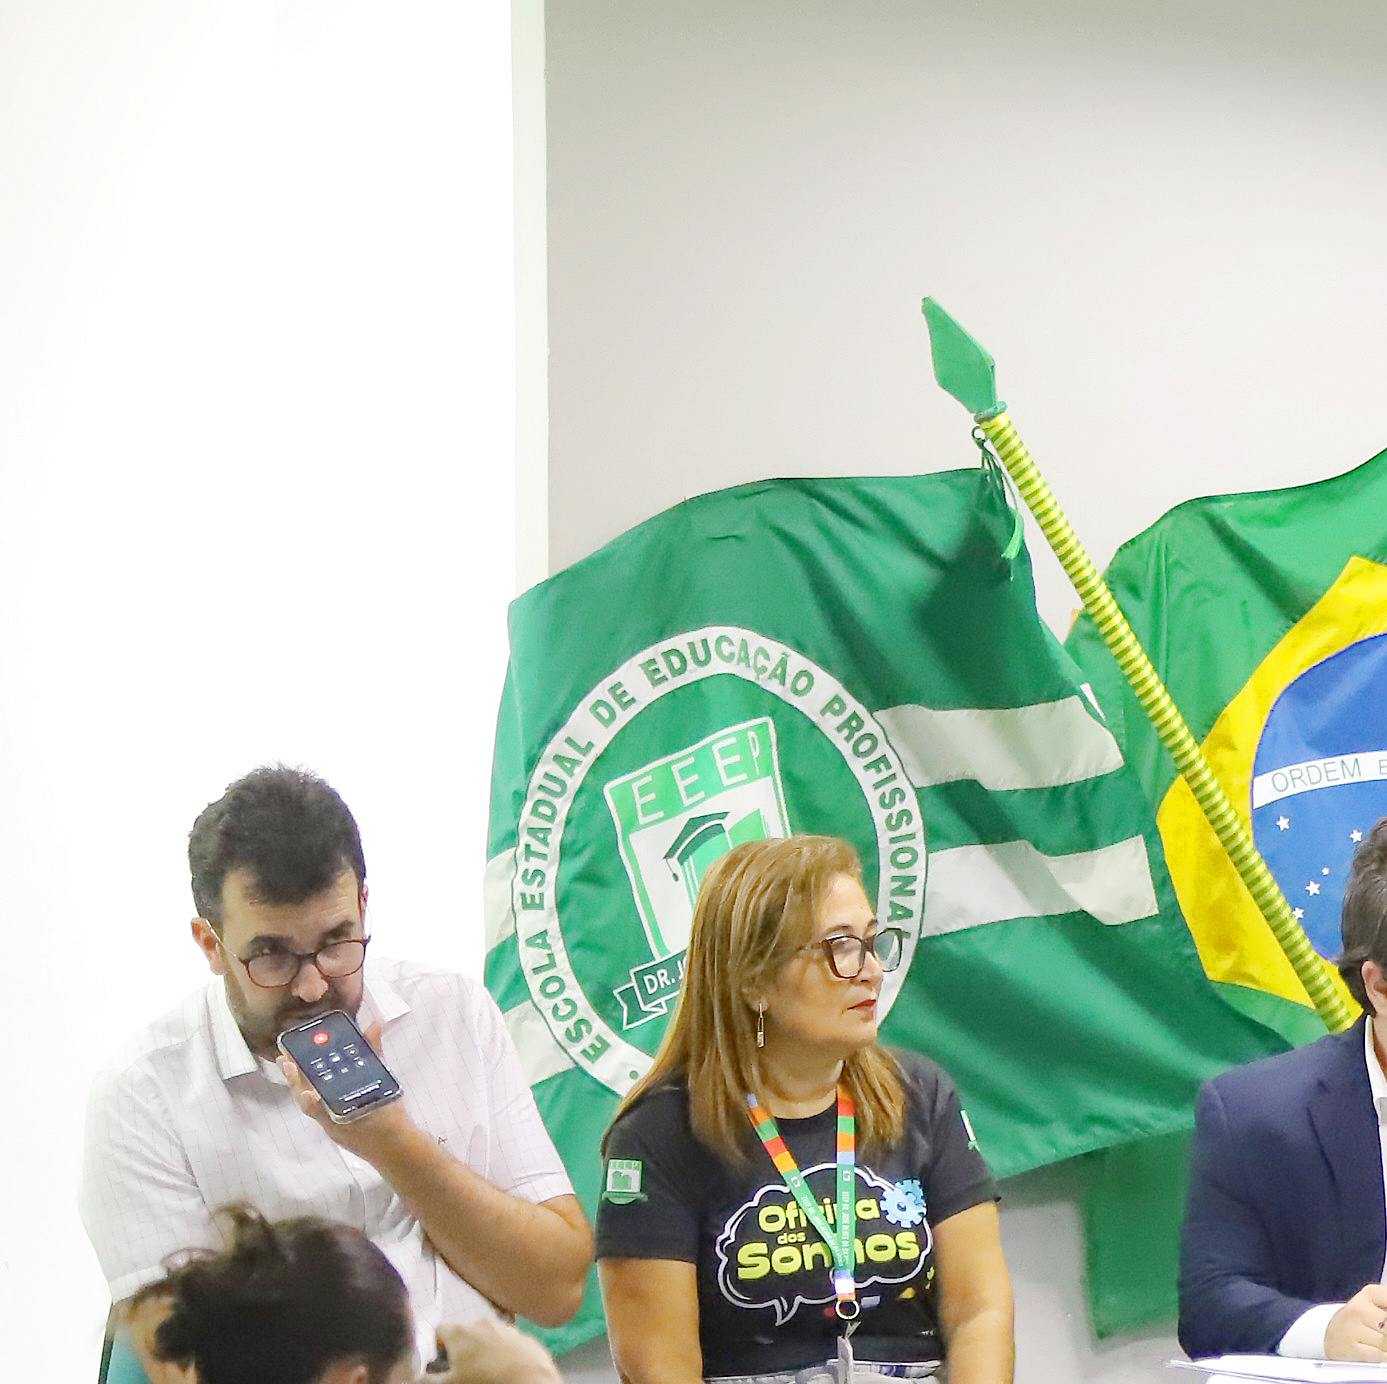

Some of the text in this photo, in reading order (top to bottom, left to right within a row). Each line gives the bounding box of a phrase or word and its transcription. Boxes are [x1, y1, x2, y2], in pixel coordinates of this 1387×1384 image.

[639, 635, 815, 697] EDUCAÇÃO
[589, 681, 637, 729] DE
[631, 731, 761, 825] EEEP
[1271, 757, 1362, 793] ORDEM
[521, 736, 594, 911] ESTADUAL
[525, 929, 613, 1065] ESCOLA
[643, 969, 676, 995] DR.
[758, 1198, 881, 1233] Ofiia
[777, 1231, 806, 1245] dos
